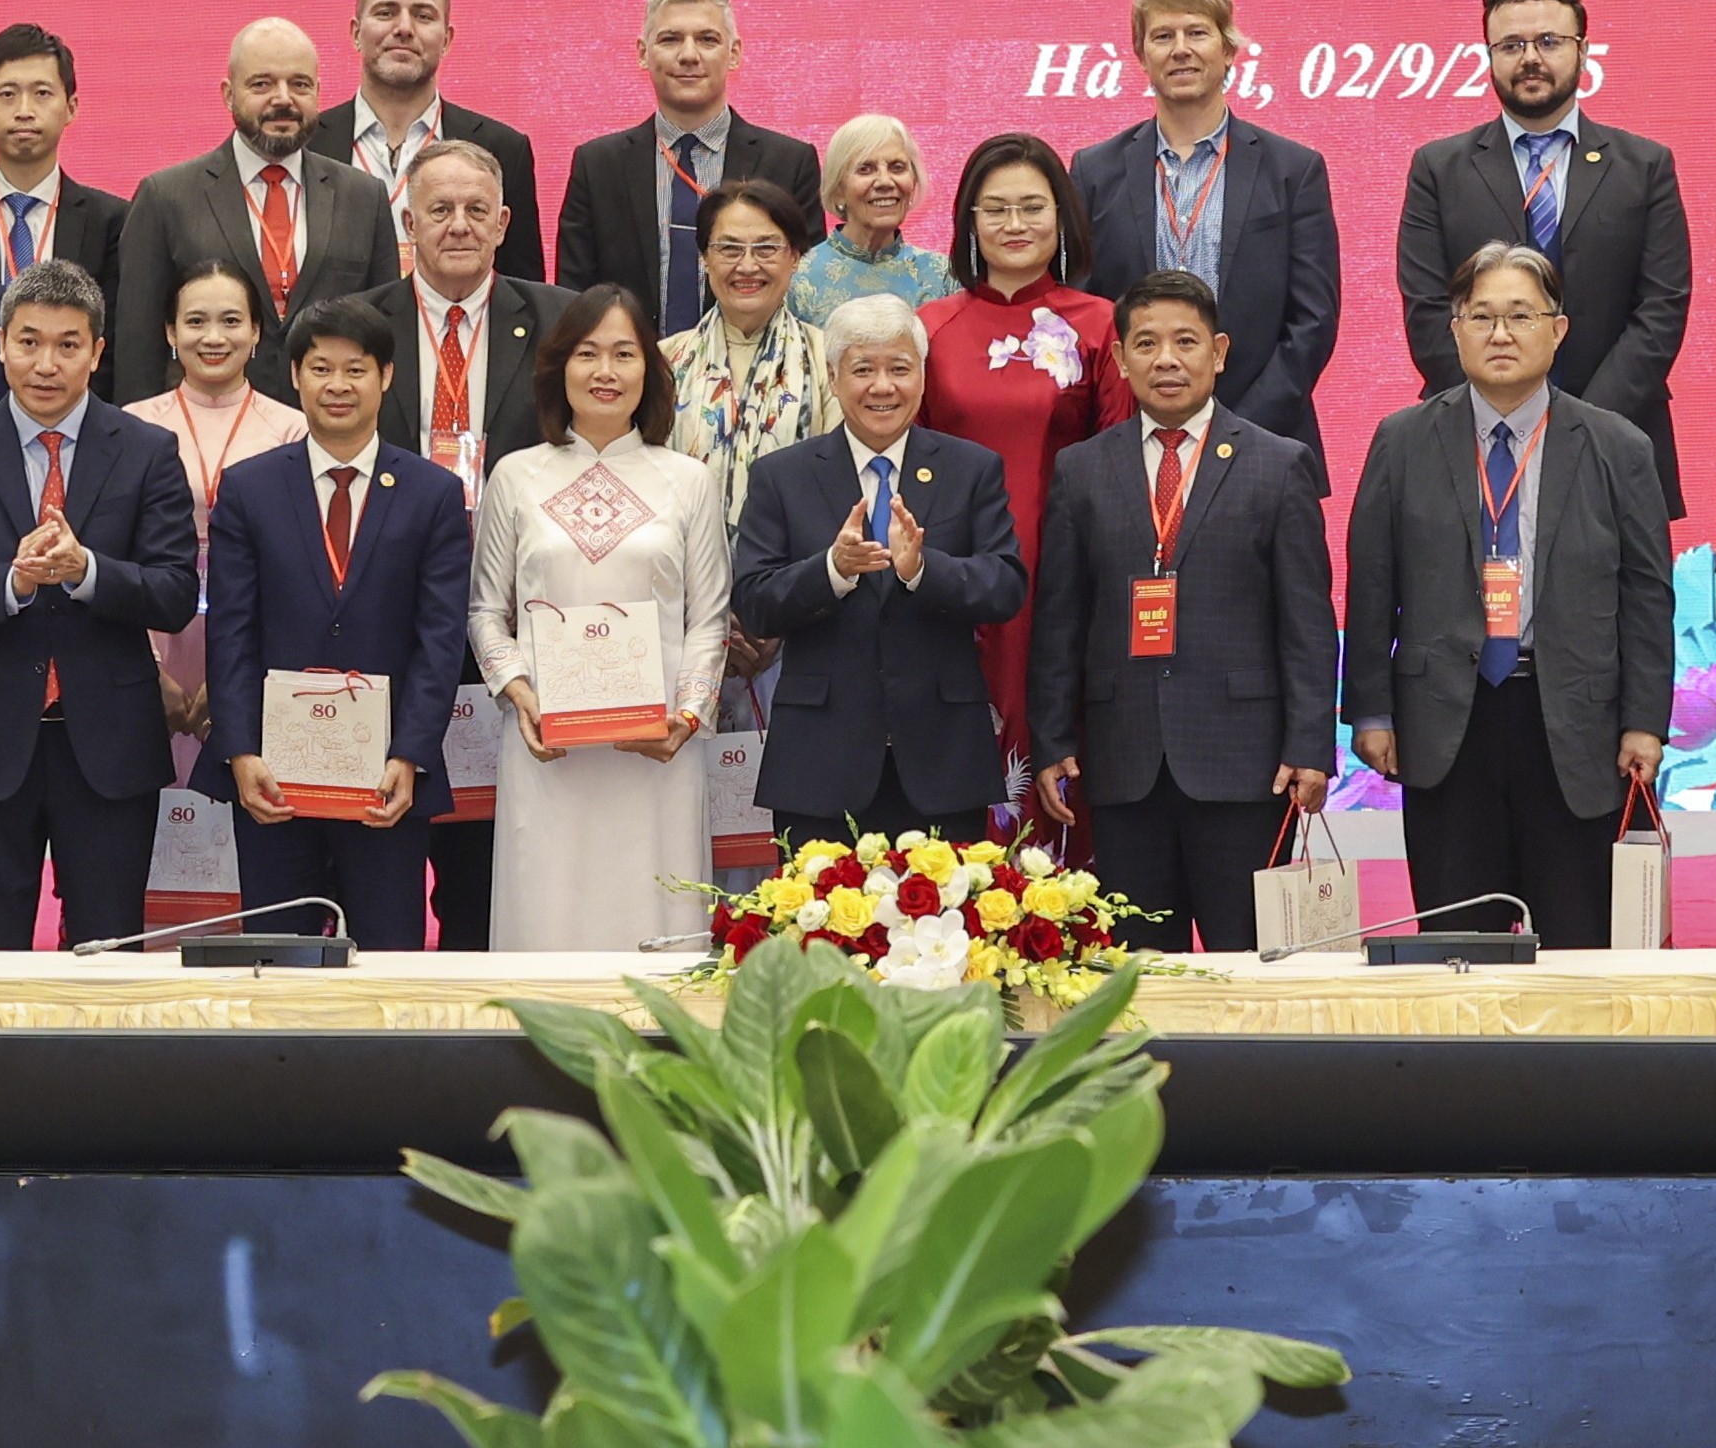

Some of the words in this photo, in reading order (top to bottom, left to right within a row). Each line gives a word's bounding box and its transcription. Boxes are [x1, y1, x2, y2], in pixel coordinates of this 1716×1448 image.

[1024, 42, 1124, 100] Hà
[1298, 42, 1610, 101] 02/9/25
[584, 622, 610, 639] 80
[312, 703, 337, 719] 80
[450, 703, 474, 719] 80
[720, 749, 746, 766] 80
[170, 806, 195, 823] 80
[1318, 882, 1333, 900] 80
